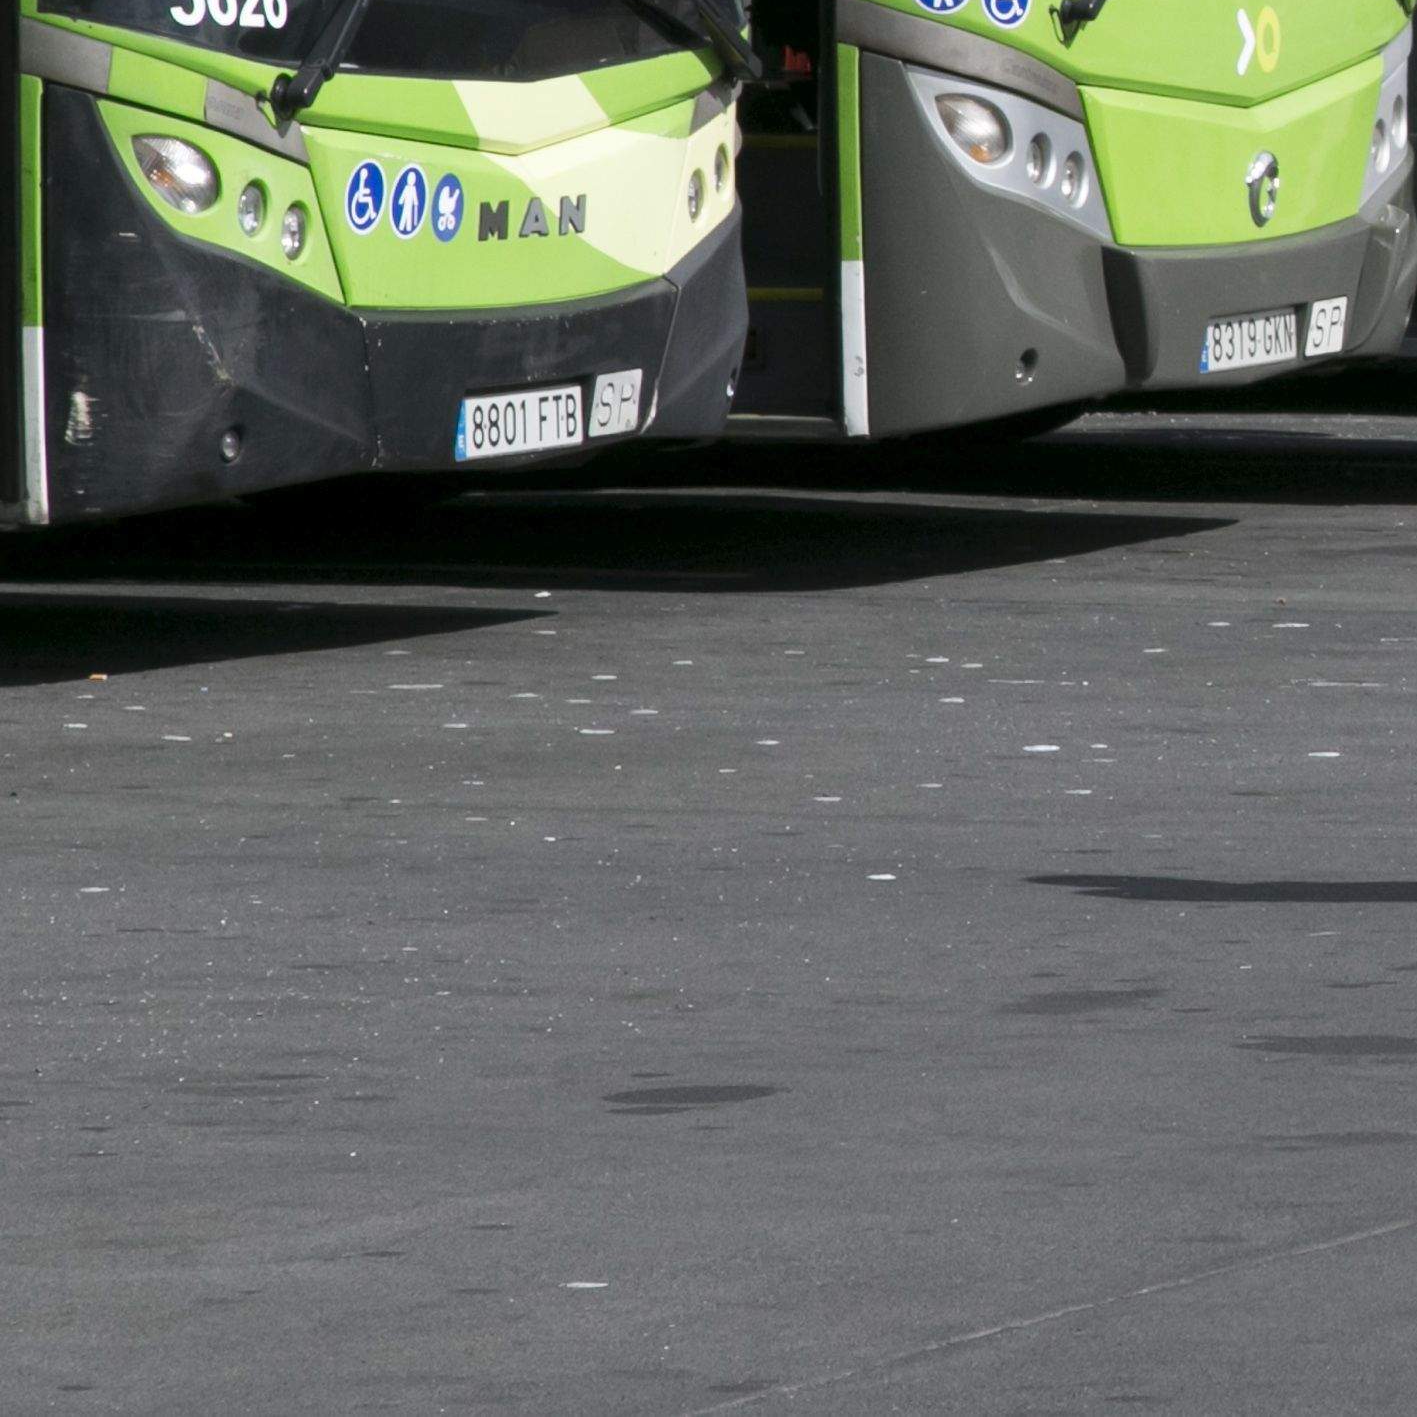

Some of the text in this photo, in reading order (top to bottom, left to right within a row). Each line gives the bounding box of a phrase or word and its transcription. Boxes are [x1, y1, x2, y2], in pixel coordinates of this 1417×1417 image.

[478, 194, 586, 242] MAN
[1212, 318, 1257, 362] 8319
[1263, 313, 1294, 354] GKN
[1313, 305, 1342, 348] SP
[472, 382, 635, 449] 8801 FTB SP
